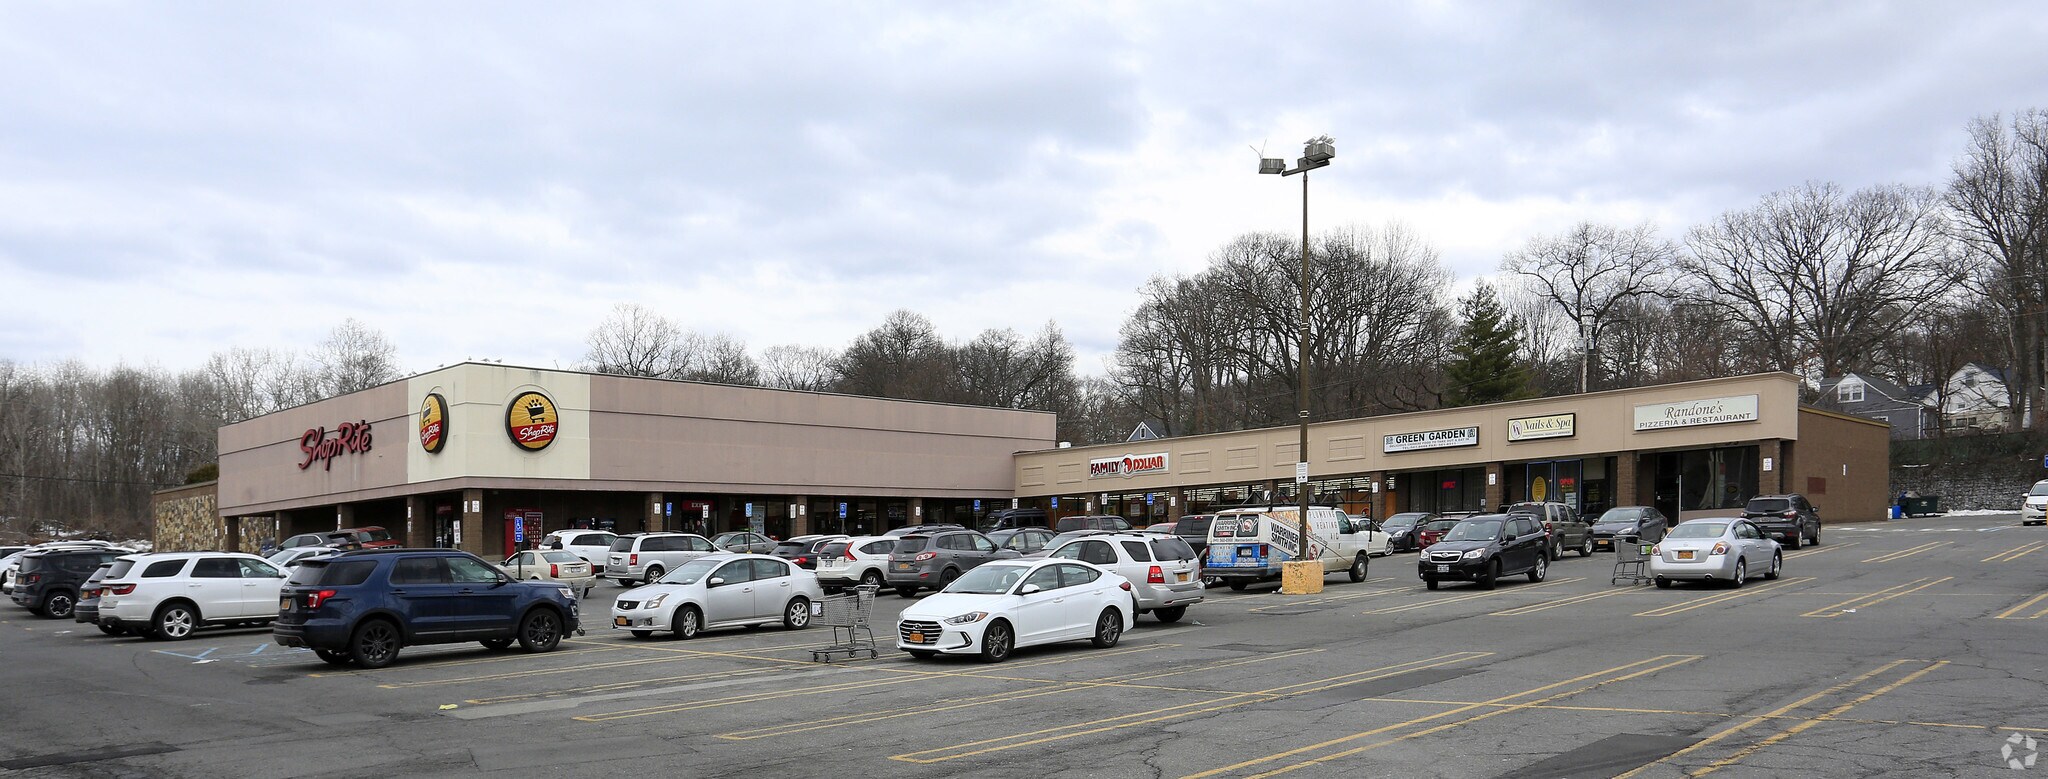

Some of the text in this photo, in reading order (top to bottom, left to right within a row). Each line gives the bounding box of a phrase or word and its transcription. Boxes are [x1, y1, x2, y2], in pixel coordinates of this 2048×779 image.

[1665, 401, 1724, 420] Randone's
[1524, 417, 1571, 431] Nails & Spa
[1639, 419, 1678, 429] PIZZERIA
[1690, 413, 1751, 424] RESTAURANT
[421, 426, 440, 445] ShopRite
[519, 426, 556, 442] ShopRite
[1395, 434, 1425, 444] GREEN
[1429, 429, 1466, 441] GARDEN
[299, 420, 373, 472] ShopRite
[1091, 456, 1163, 475] FAMILY DOLLAR
[1270, 521, 1299, 545] WARRINER
[1316, 521, 1338, 530] HEATING
[1270, 532, 1288, 549] SMITH
